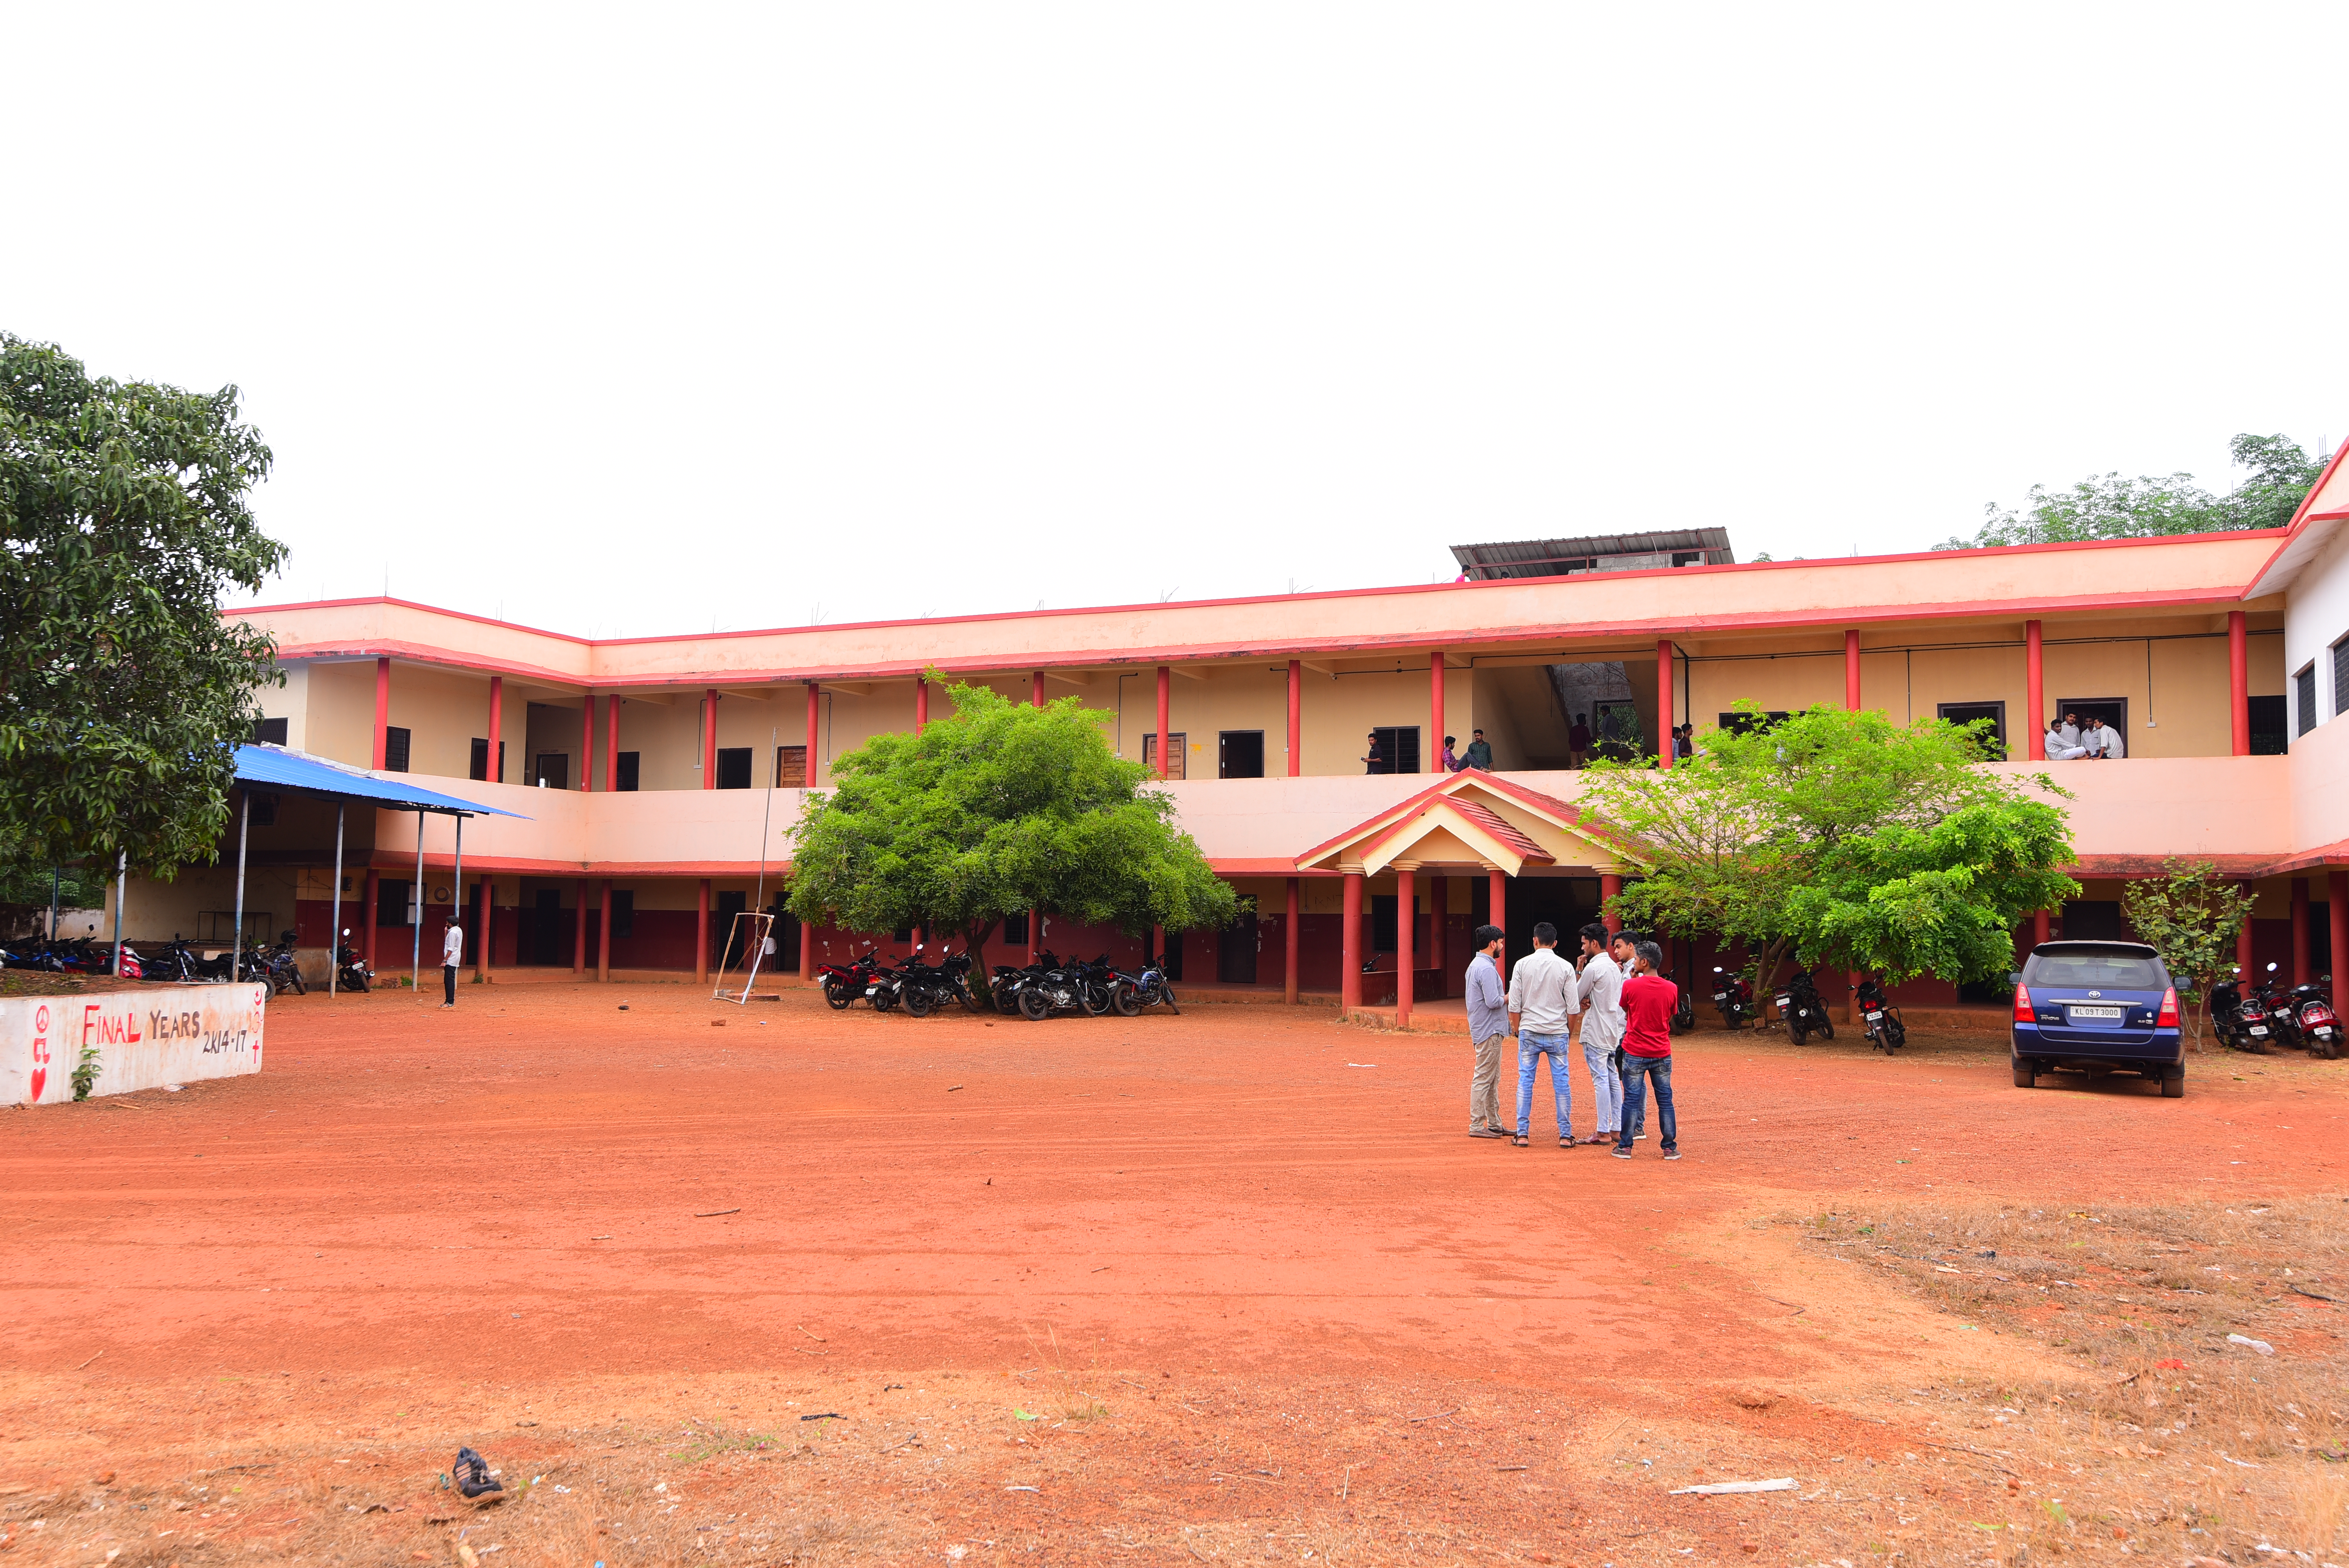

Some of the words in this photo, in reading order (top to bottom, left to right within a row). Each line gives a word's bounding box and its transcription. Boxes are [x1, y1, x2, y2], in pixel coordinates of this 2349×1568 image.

[83, 1005, 142, 1045] FINAL
[150, 1009, 200, 1039] YEARS
[203, 1030, 247, 1054] 2K14-17
